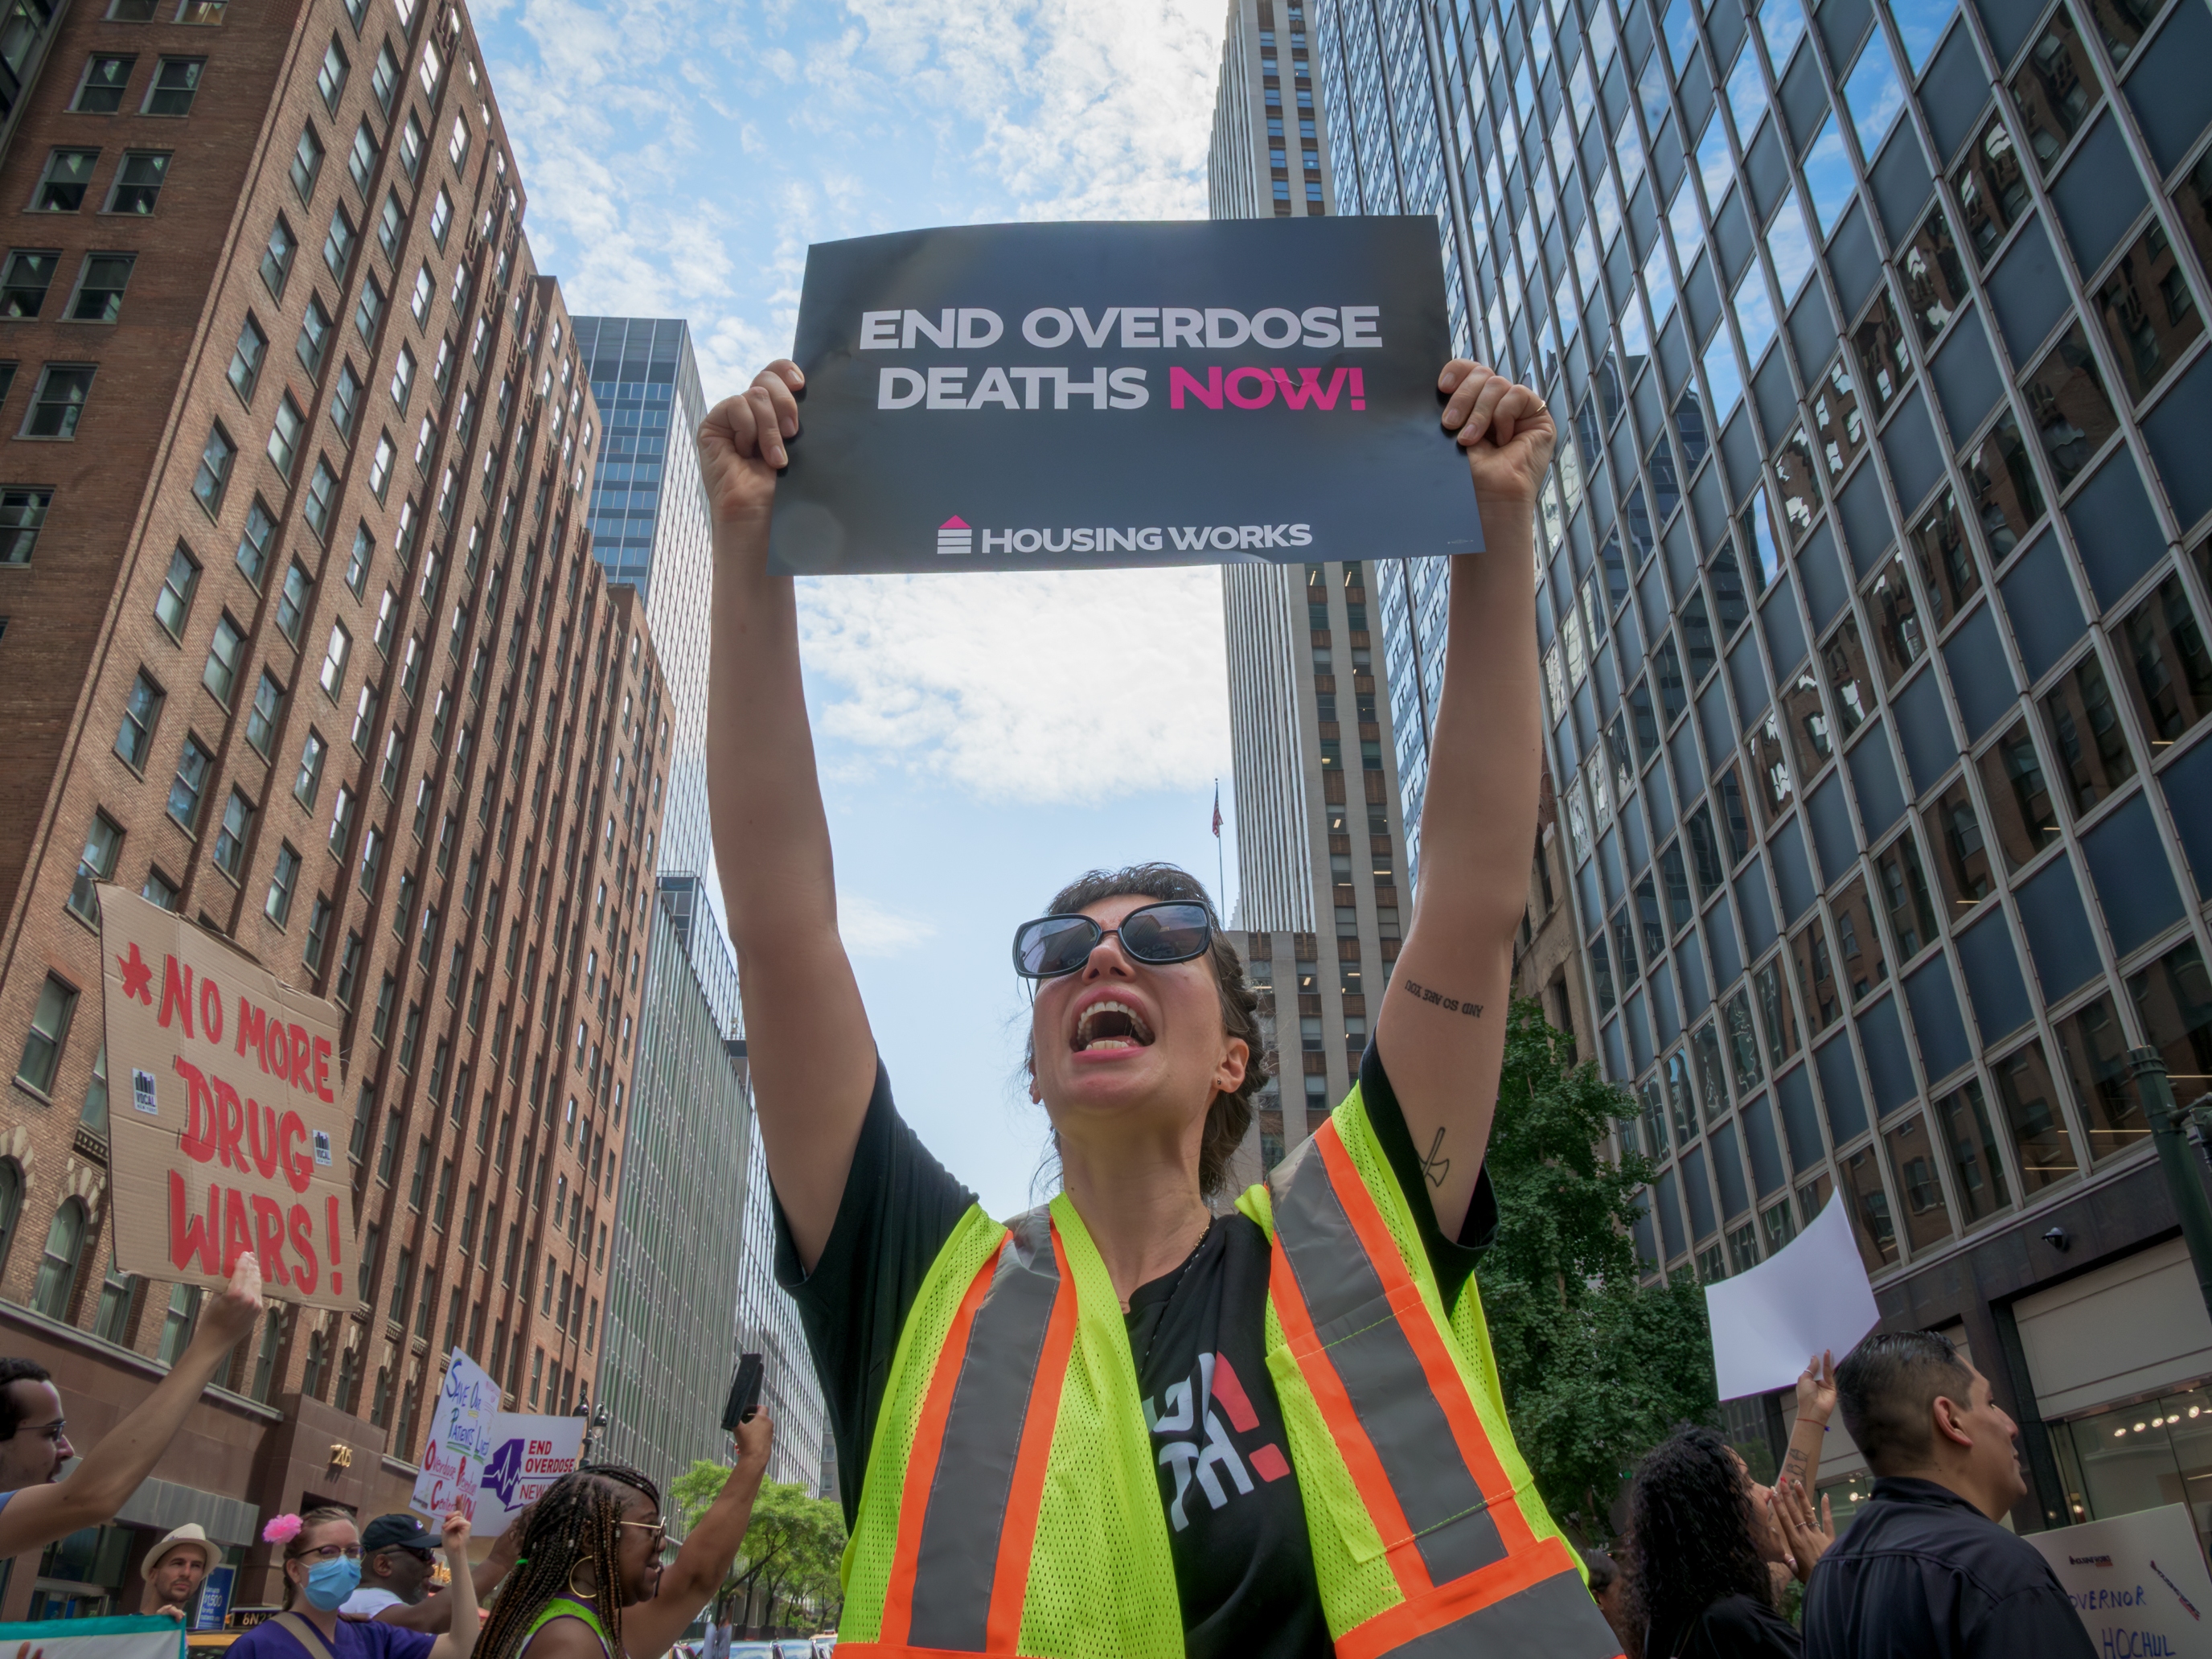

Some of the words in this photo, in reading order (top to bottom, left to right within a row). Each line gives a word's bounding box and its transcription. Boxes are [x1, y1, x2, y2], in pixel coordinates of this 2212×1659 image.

[860, 307, 1004, 351] END
[1022, 305, 1383, 350] OVERDOSE
[877, 367, 1149, 411] DEATHS
[1169, 366, 1366, 411] NOW!
[982, 526, 1162, 554] HOUSING
[1168, 524, 1313, 551] WORKS
[1405, 979, 1422, 998] YOU
[1422, 988, 1443, 1006] ARE
[1444, 998, 1459, 1012] SO
[1461, 1003, 1484, 1018] AND
[236, 996, 334, 1103] MORE
[174, 1055, 314, 1193] DRUG
[169, 1168, 343, 1296] WARS!
[528, 1439, 552, 1456] END
[525, 1458, 575, 1473] OVERDOSE
[519, 1484, 546, 1500] NEW
[2069, 1585, 2147, 1611] OVERNOR
[2102, 1627, 2176, 1659] HOCHUL
